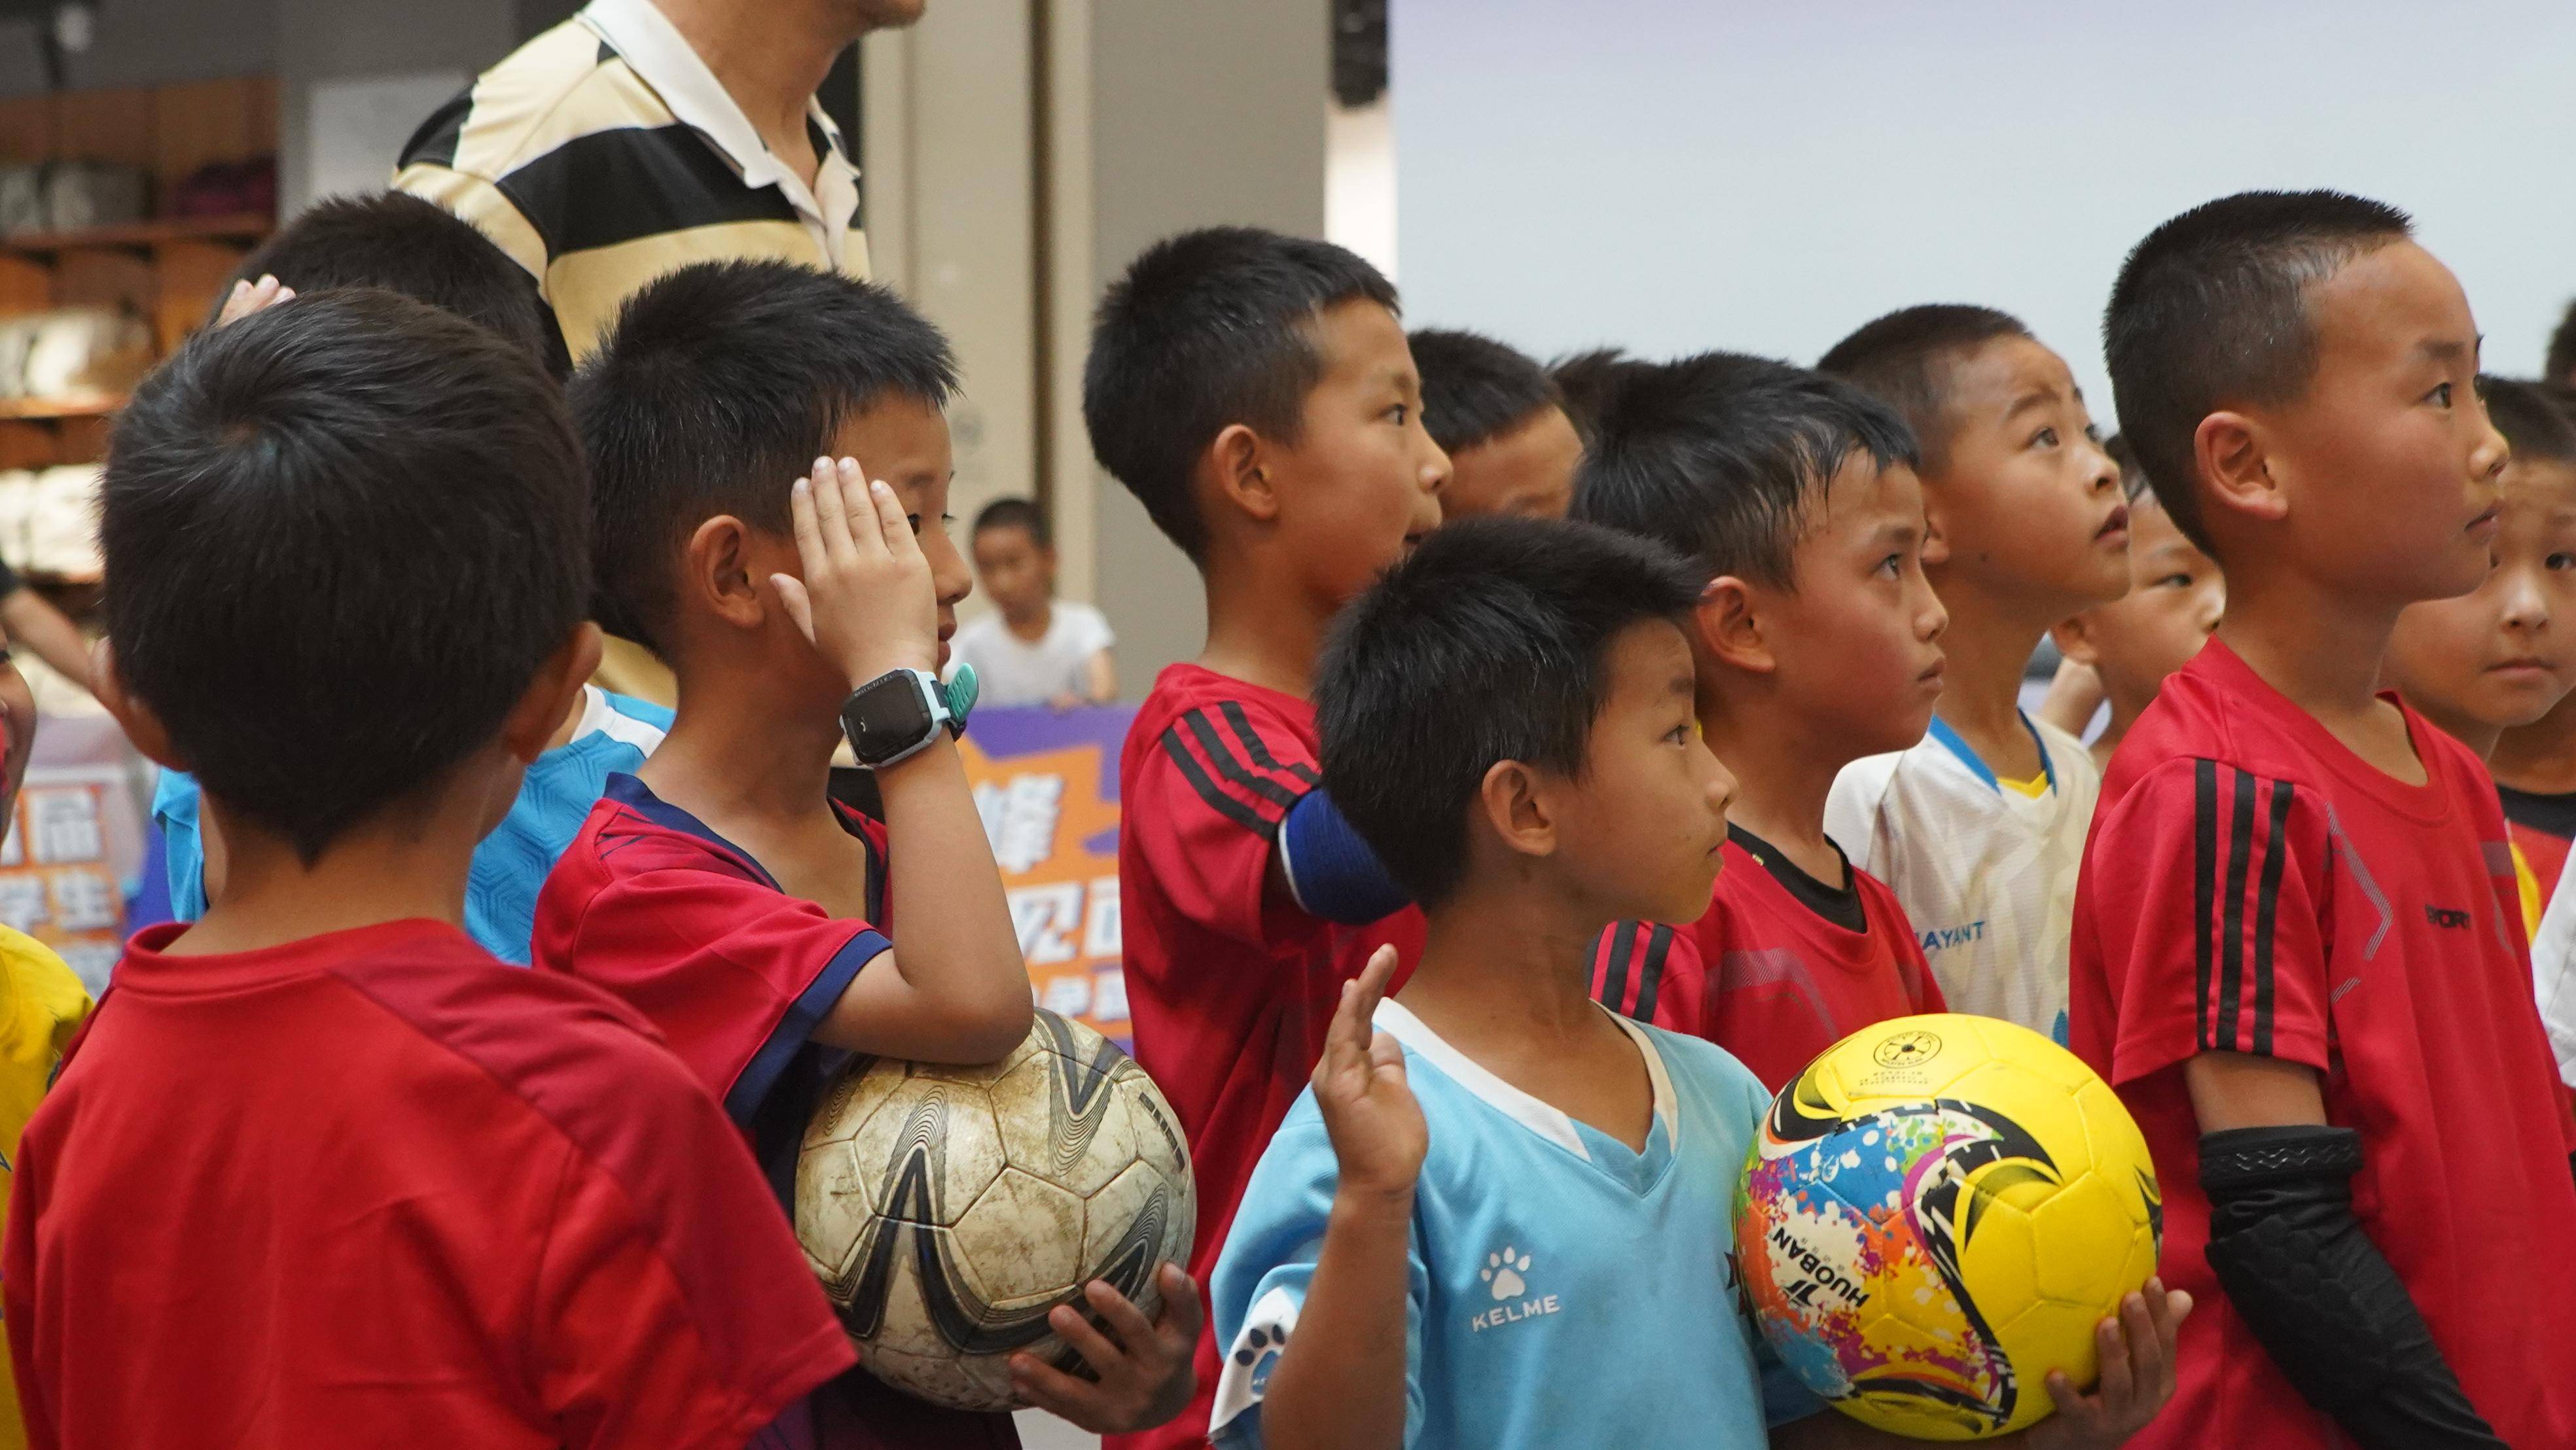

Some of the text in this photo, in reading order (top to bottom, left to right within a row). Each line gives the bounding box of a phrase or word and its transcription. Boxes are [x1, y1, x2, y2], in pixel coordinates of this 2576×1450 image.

[1913, 921, 1986, 950] AYANT
[1772, 1226, 1870, 1308] HUOBAN
[1473, 1294, 1561, 1332] KELME
